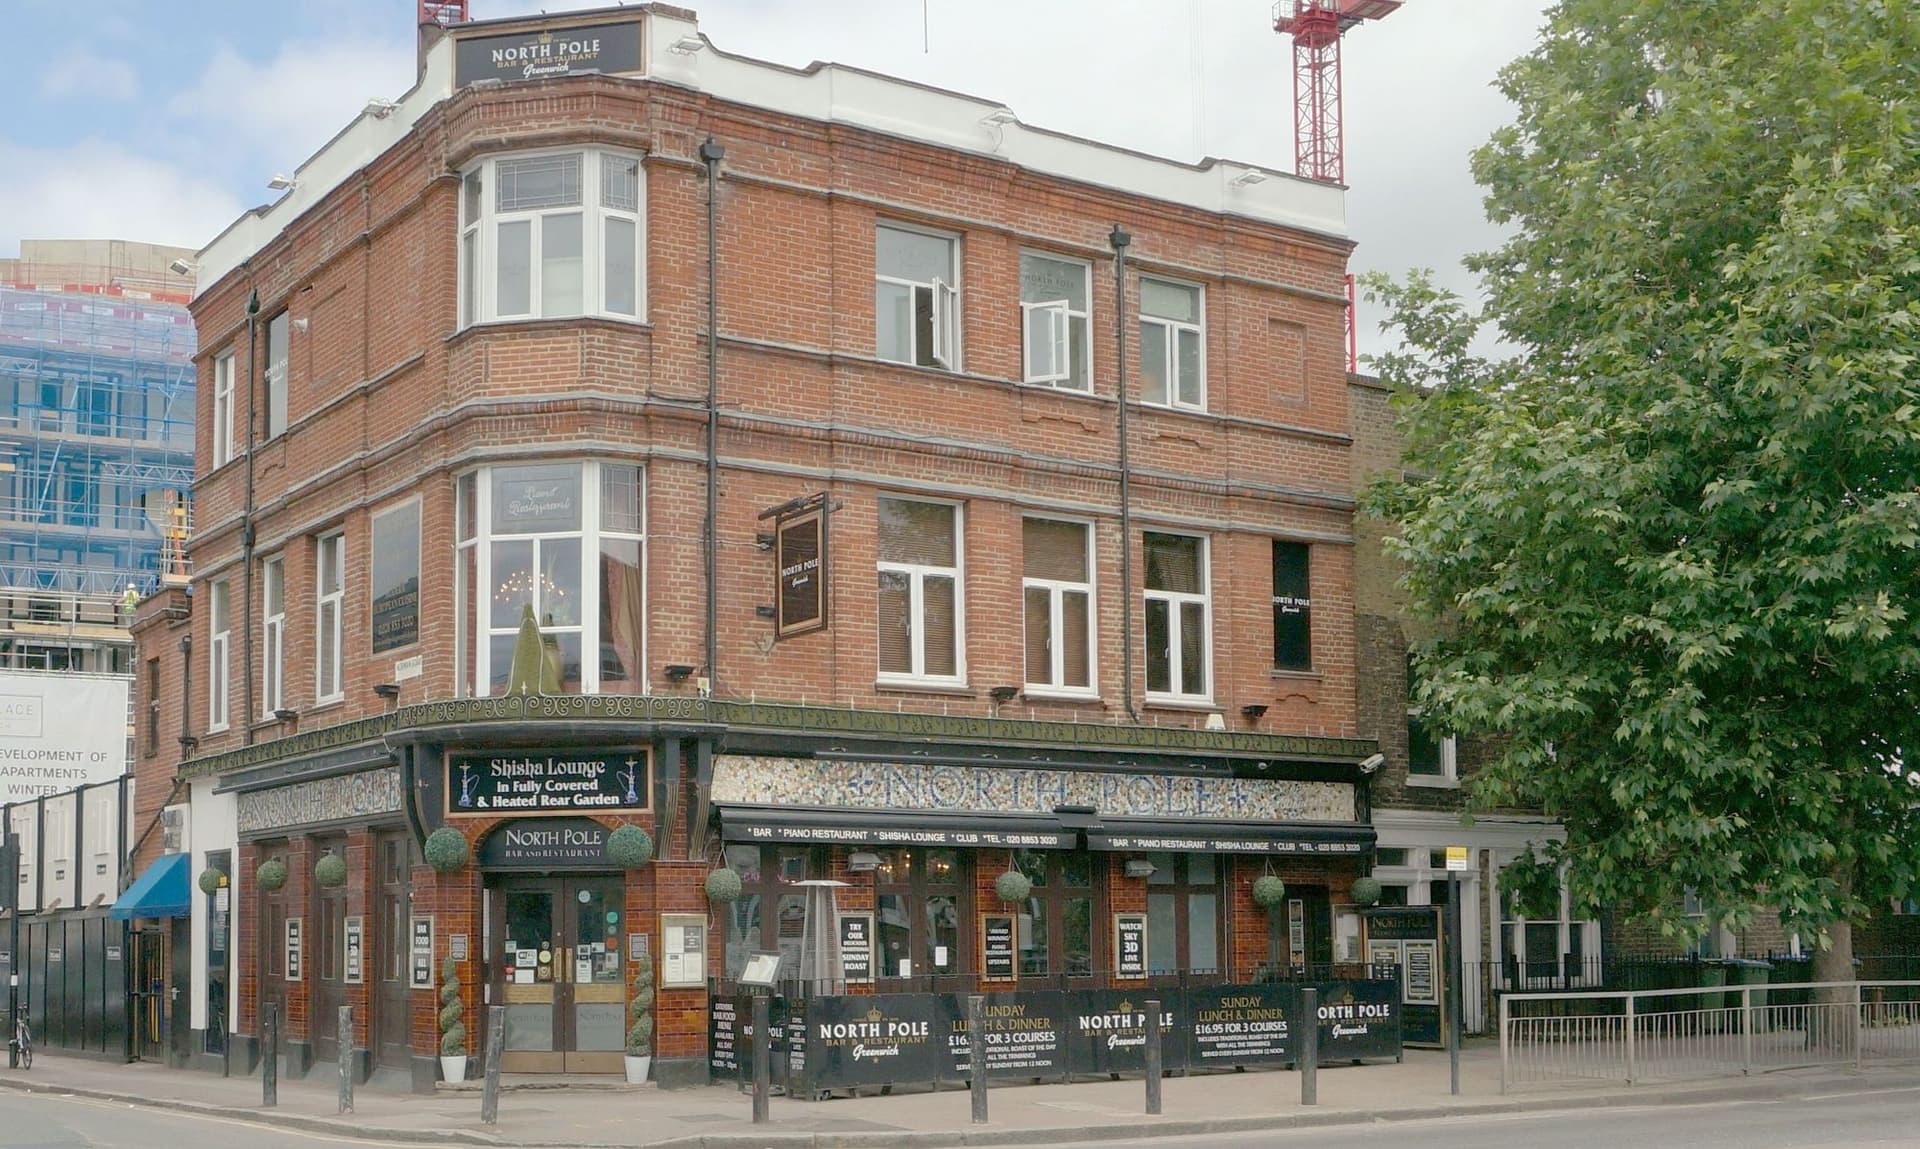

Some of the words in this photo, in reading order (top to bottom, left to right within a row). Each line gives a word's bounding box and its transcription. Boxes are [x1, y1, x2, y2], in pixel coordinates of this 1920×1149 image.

[492, 44, 551, 62] NORTH
[559, 39, 601, 55] POLE
[534, 52, 598, 64] RESTAURANT
[523, 61, 569, 78] Greenwich
[782, 563, 802, 577] NORTH
[803, 558, 819, 570] POLE
[1272, 596, 1293, 604] NORTH
[1294, 598, 1310, 606] POLE
[90, 752, 108, 762] OF
[0, 767, 88, 779] APARTMENTS
[490, 759, 544, 778] Shisha
[547, 758, 606, 778] Lounge
[7, 784, 58, 796] WINTER
[497, 781, 511, 793] in
[513, 780, 542, 795] Fully
[544, 780, 598, 792] Covered
[884, 764, 1065, 814] NORTH
[1102, 774, 1217, 816] POLE
[248, 784, 325, 826] NORTH
[477, 797, 490, 808] &
[492, 795, 537, 807] Heated
[540, 794, 570, 806] Rear
[573, 794, 620, 806] Garden
[505, 829, 559, 847] NORTH
[564, 828, 602, 846] POLE
[753, 827, 773, 837] BAR
[783, 828, 811, 838] PIANO
[812, 829, 868, 840] RESTAURANT
[879, 831, 911, 841] SHISHA
[911, 832, 945, 842] LOUNGE
[956, 833, 978, 843] CLUB
[1112, 838, 1129, 847] BAR
[1137, 839, 1160, 848] PIANO
[1161, 839, 1207, 849] RESTAURANT
[1215, 841, 1241, 850] SHISHA
[1241, 841, 1269, 850] LOUNGE
[1277, 842, 1296, 850] CLUB
[505, 849, 522, 857] BAR
[542, 849, 600, 857] RESTAURANT
[848, 923, 862, 931] TRY
[847, 932, 864, 940] OUR
[1123, 933, 1138, 941] SKY
[1124, 942, 1139, 953] 3D
[844, 962, 867, 970] ROAST
[1221, 996, 1262, 1009] SUNDAY
[985, 1005, 1026, 1017] UNDAY
[1199, 1010, 1234, 1022] LUNCH
[1236, 1010, 1245, 1020] &
[1247, 1008, 1283, 1020] DINNER
[1317, 1005, 1354, 1019] ORTH
[1358, 1004, 1390, 1017] POLE
[952, 1020, 993, 1032] LUH
[996, 1020, 1006, 1030] &
[1008, 1018, 1051, 1030] DINNER
[1078, 1014, 1131, 1030] NORTH
[1138, 1012, 1174, 1027] PLE
[1340, 1016, 1388, 1024] RESTAURANT
[820, 1023, 880, 1039] NORTH
[887, 1021, 929, 1037] POLE
[1084, 1029, 1102, 1037] BAR
[1195, 1023, 1224, 1034] £16.95
[1225, 1022, 1242, 1033] FOR
[1242, 1022, 1249, 1032] 3
[1249, 1021, 1288, 1032] COURSES
[825, 1038, 847, 1047] BAR
[863, 1036, 928, 1045] RESTAURANT
[1004, 1033, 1010, 1043] 3
[1012, 1031, 1056, 1042] COURSES
[852, 1043, 899, 1061] Greenwich
